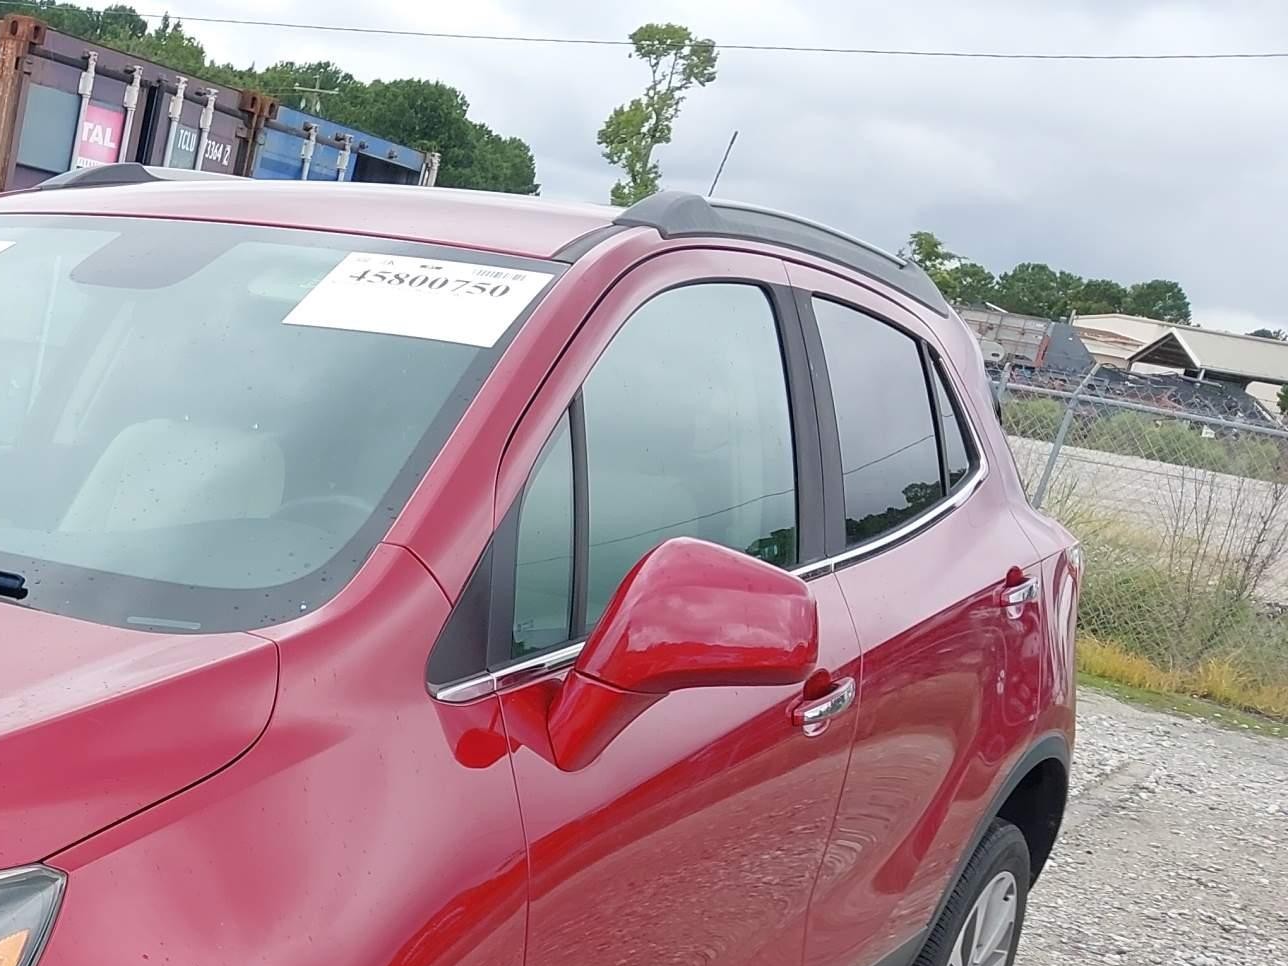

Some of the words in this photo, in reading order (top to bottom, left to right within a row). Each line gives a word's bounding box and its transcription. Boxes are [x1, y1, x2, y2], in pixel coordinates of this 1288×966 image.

[81, 121, 116, 149] TAL
[177, 129, 197, 152] TCLU
[349, 268, 511, 298] 45800750
